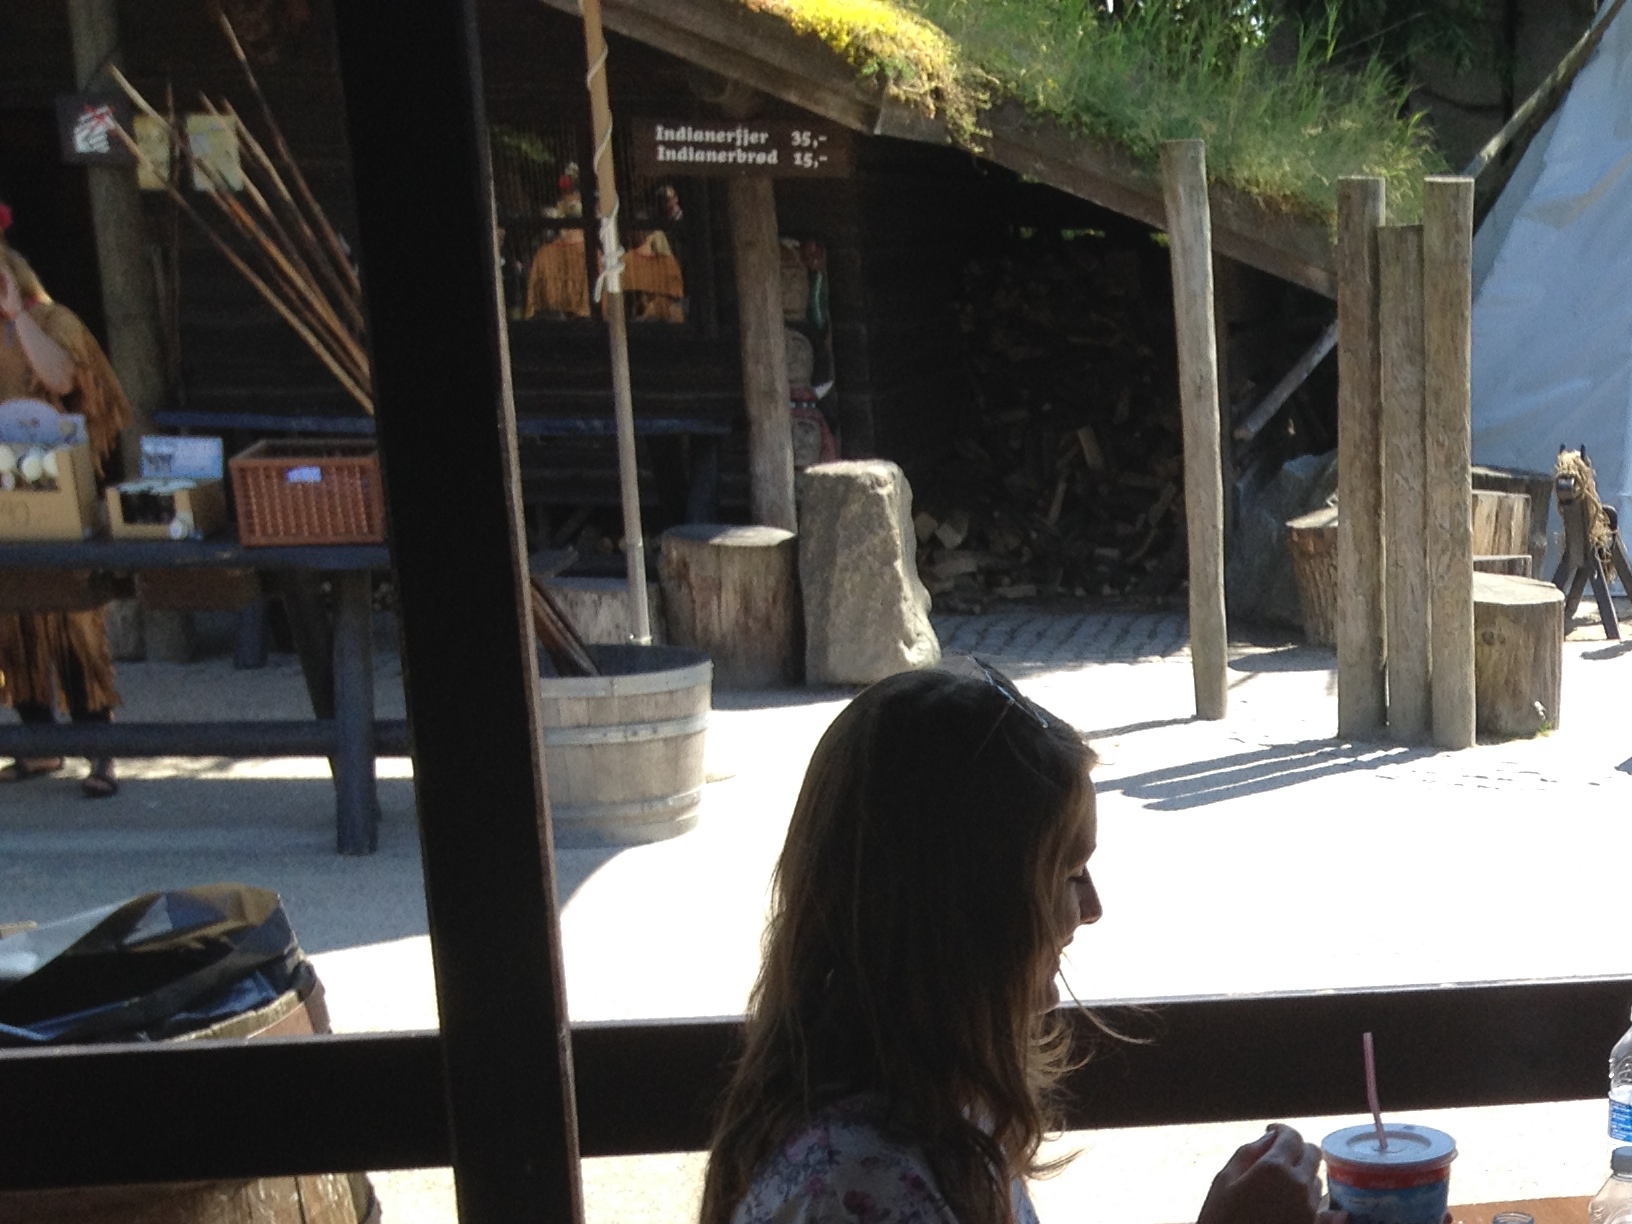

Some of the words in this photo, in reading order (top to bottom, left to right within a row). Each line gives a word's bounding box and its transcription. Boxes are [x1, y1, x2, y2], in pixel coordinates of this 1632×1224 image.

[655, 125, 769, 146] Indianerfjer
[791, 129, 827, 148] 35,-
[656, 147, 778, 165] Indianerbrød
[793, 152, 828, 169] 15,-
